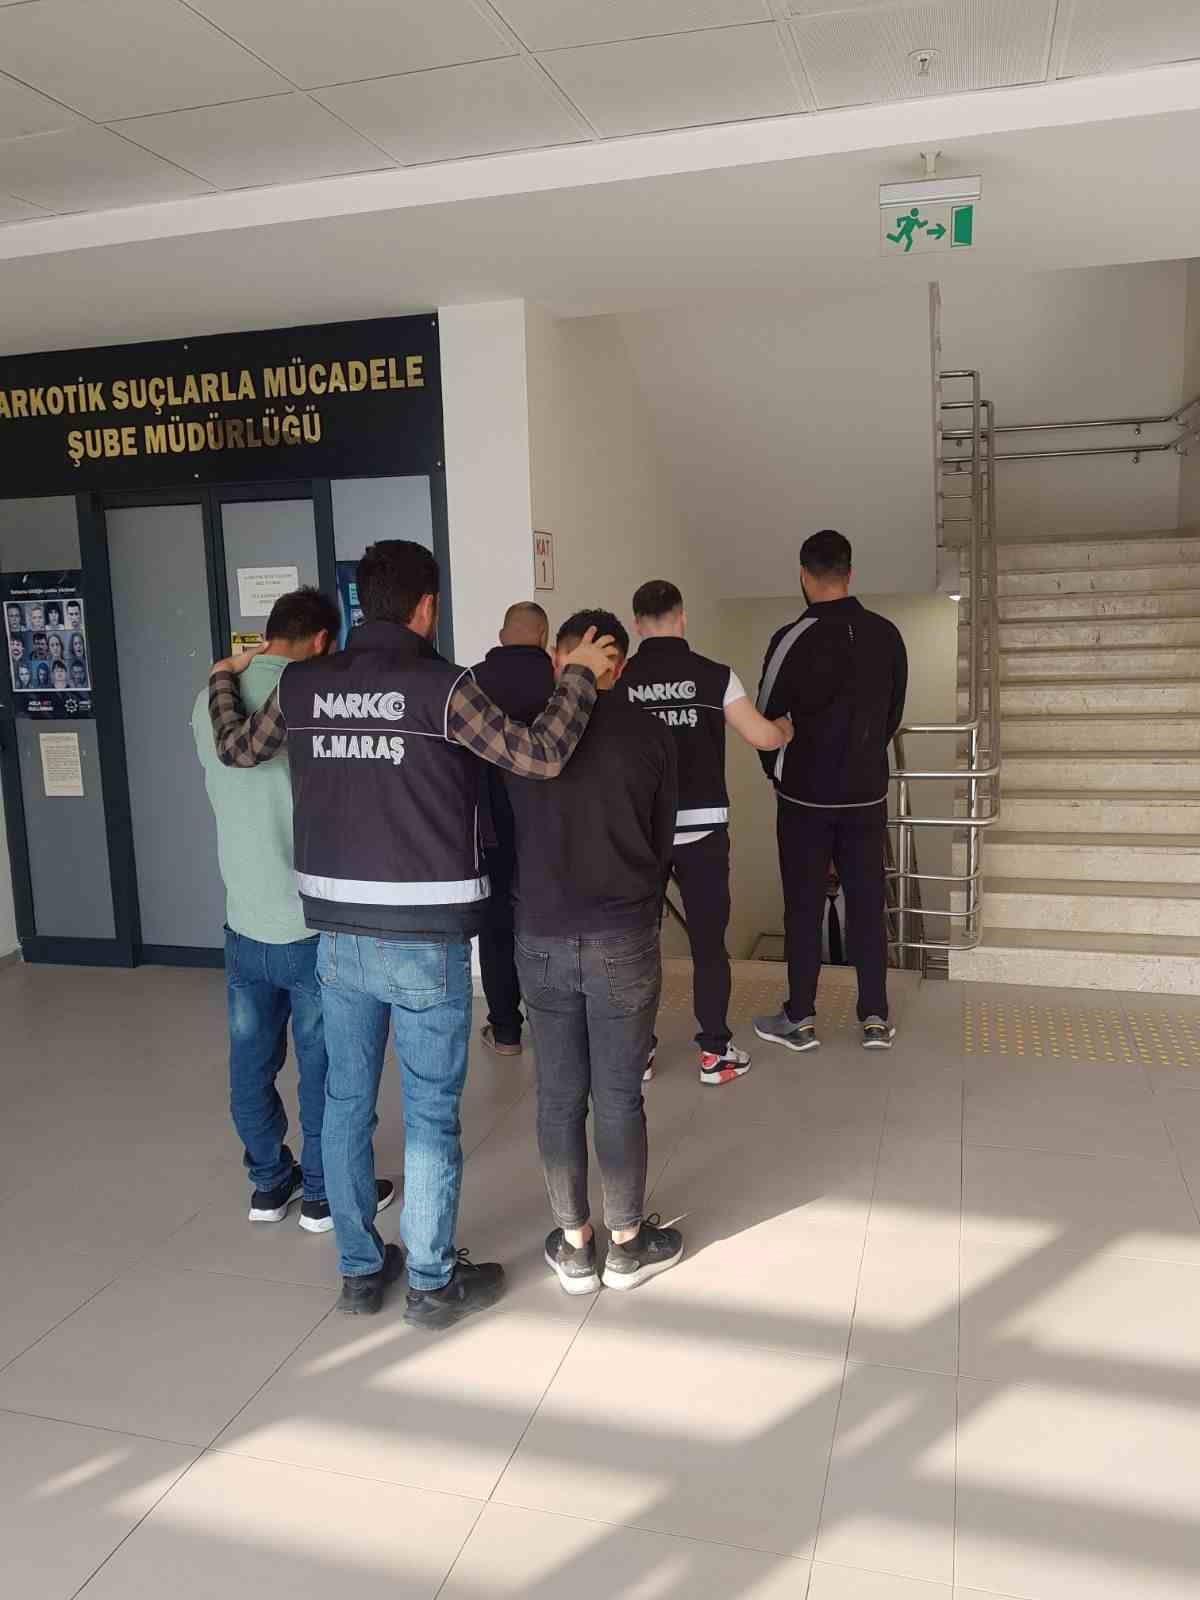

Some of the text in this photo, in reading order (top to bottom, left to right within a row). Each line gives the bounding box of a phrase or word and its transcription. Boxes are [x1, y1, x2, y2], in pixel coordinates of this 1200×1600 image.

[112, 369, 257, 415] SUÇLARLA
[264, 355, 425, 398] MÜCADELE
[67, 405, 321, 467] ŞUBE MÜDÜRLÜĞÜ
[312, 735, 405, 765] K.MARAŞ
